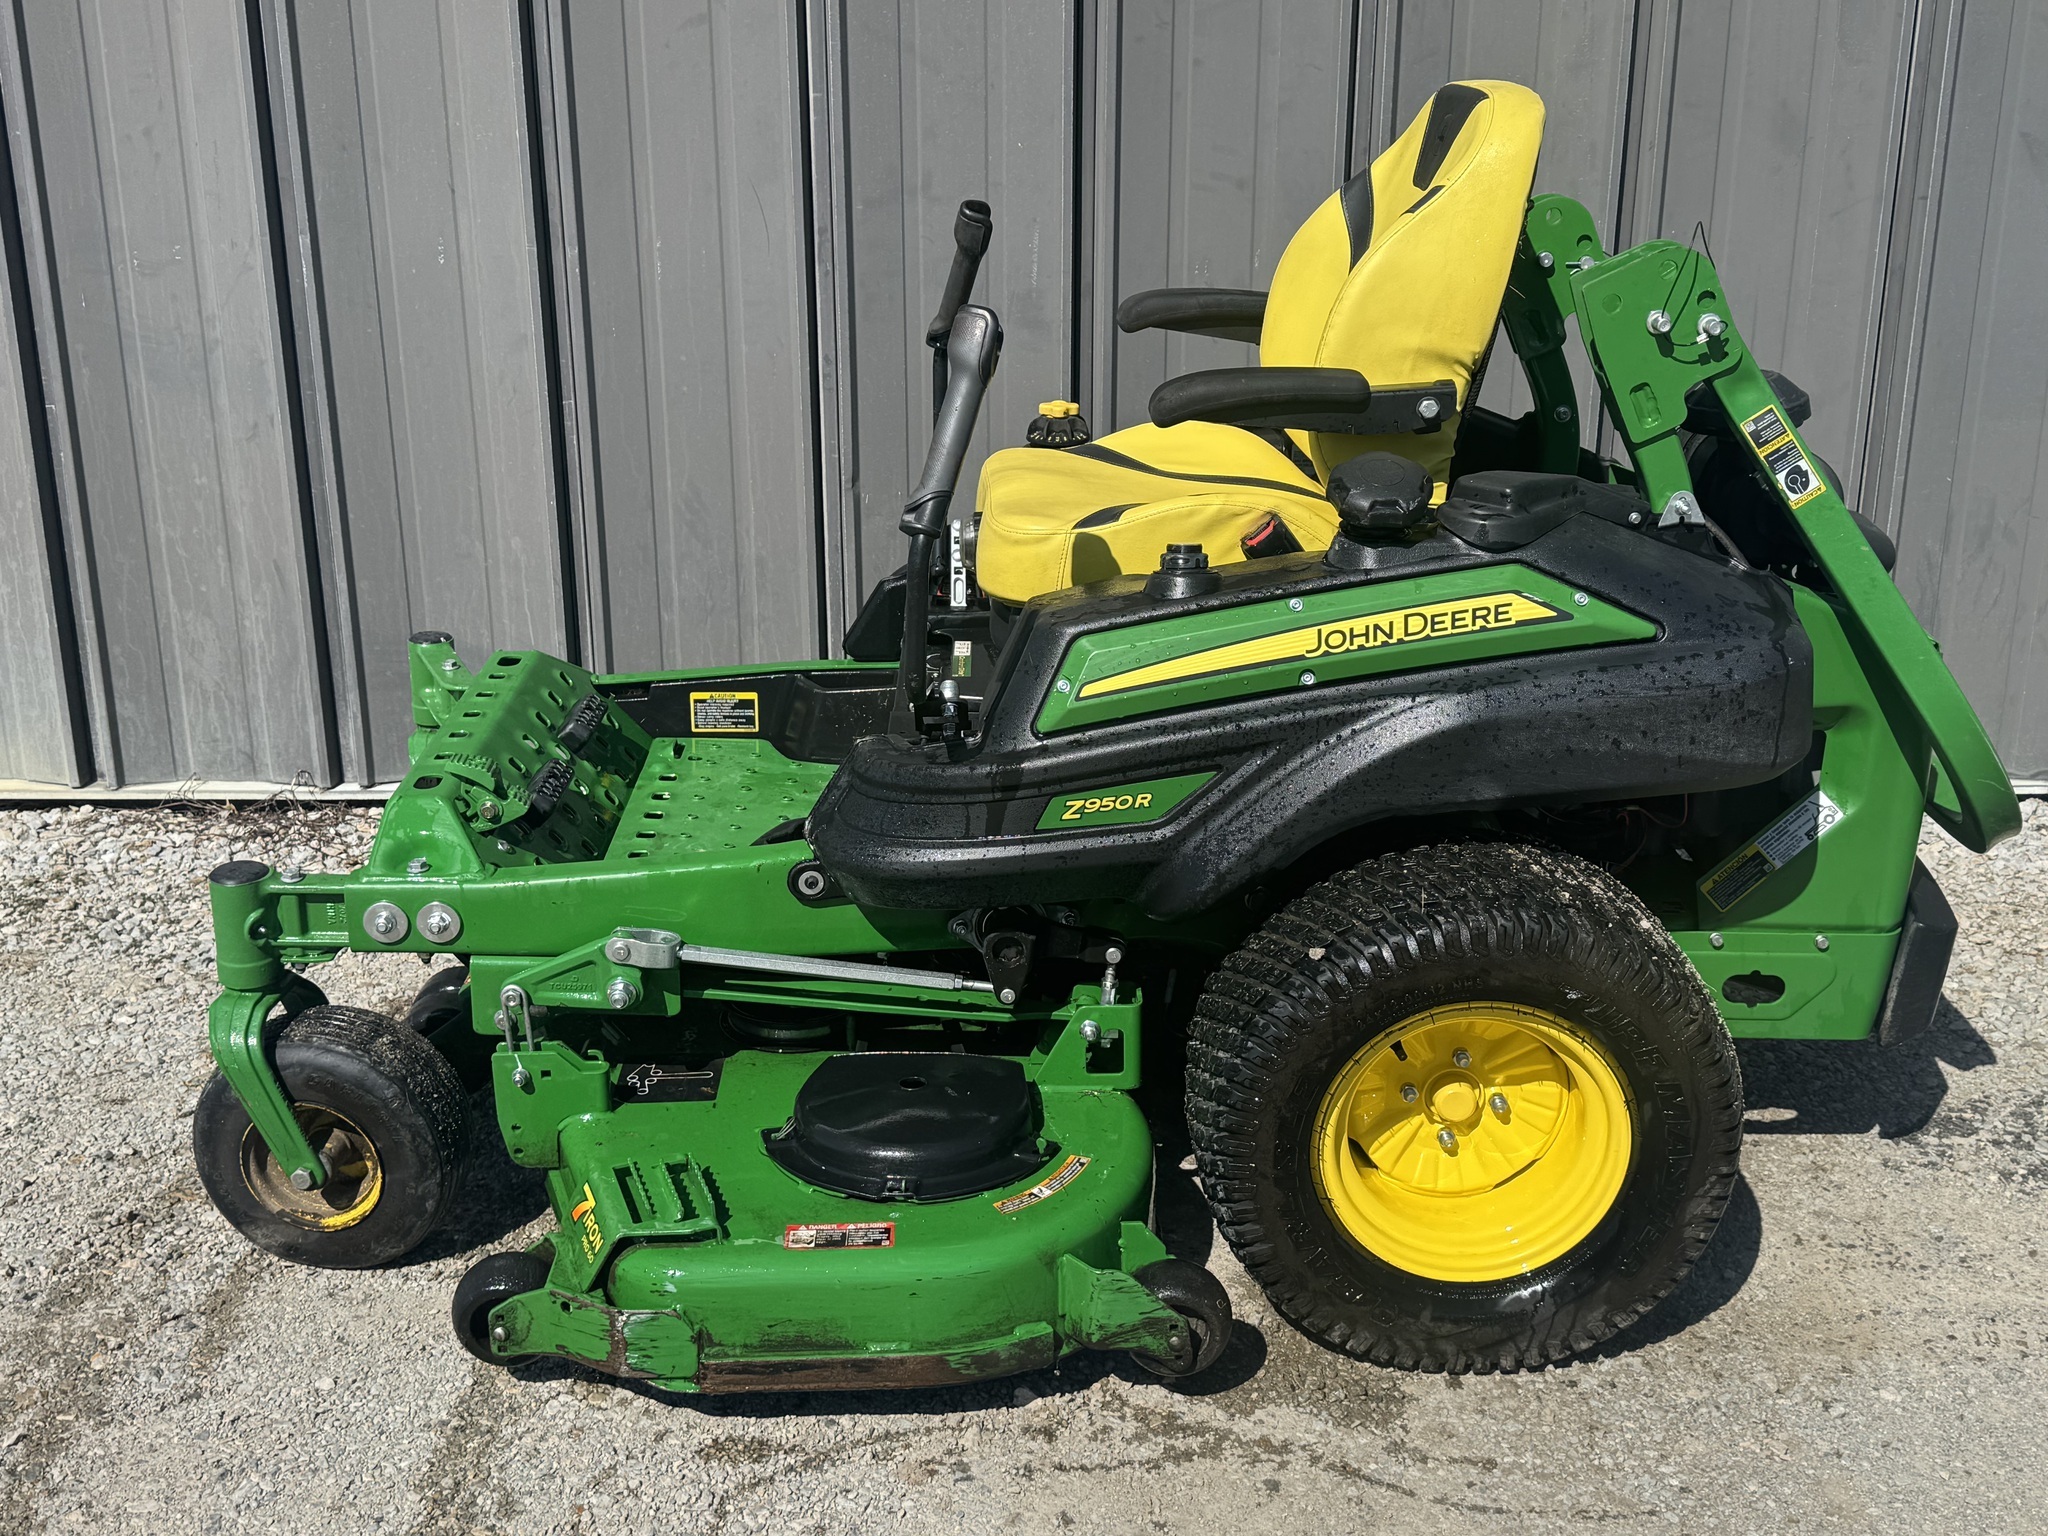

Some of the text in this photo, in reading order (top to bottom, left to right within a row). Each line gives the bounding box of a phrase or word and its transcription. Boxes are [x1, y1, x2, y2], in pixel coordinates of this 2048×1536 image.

[1305, 603, 1514, 655] JOHN DEERE
[1061, 792, 1153, 820] Z950R
[1717, 853, 1749, 881] ATENCIÓN
[1555, 981, 1695, 1281] TURF MASTER
